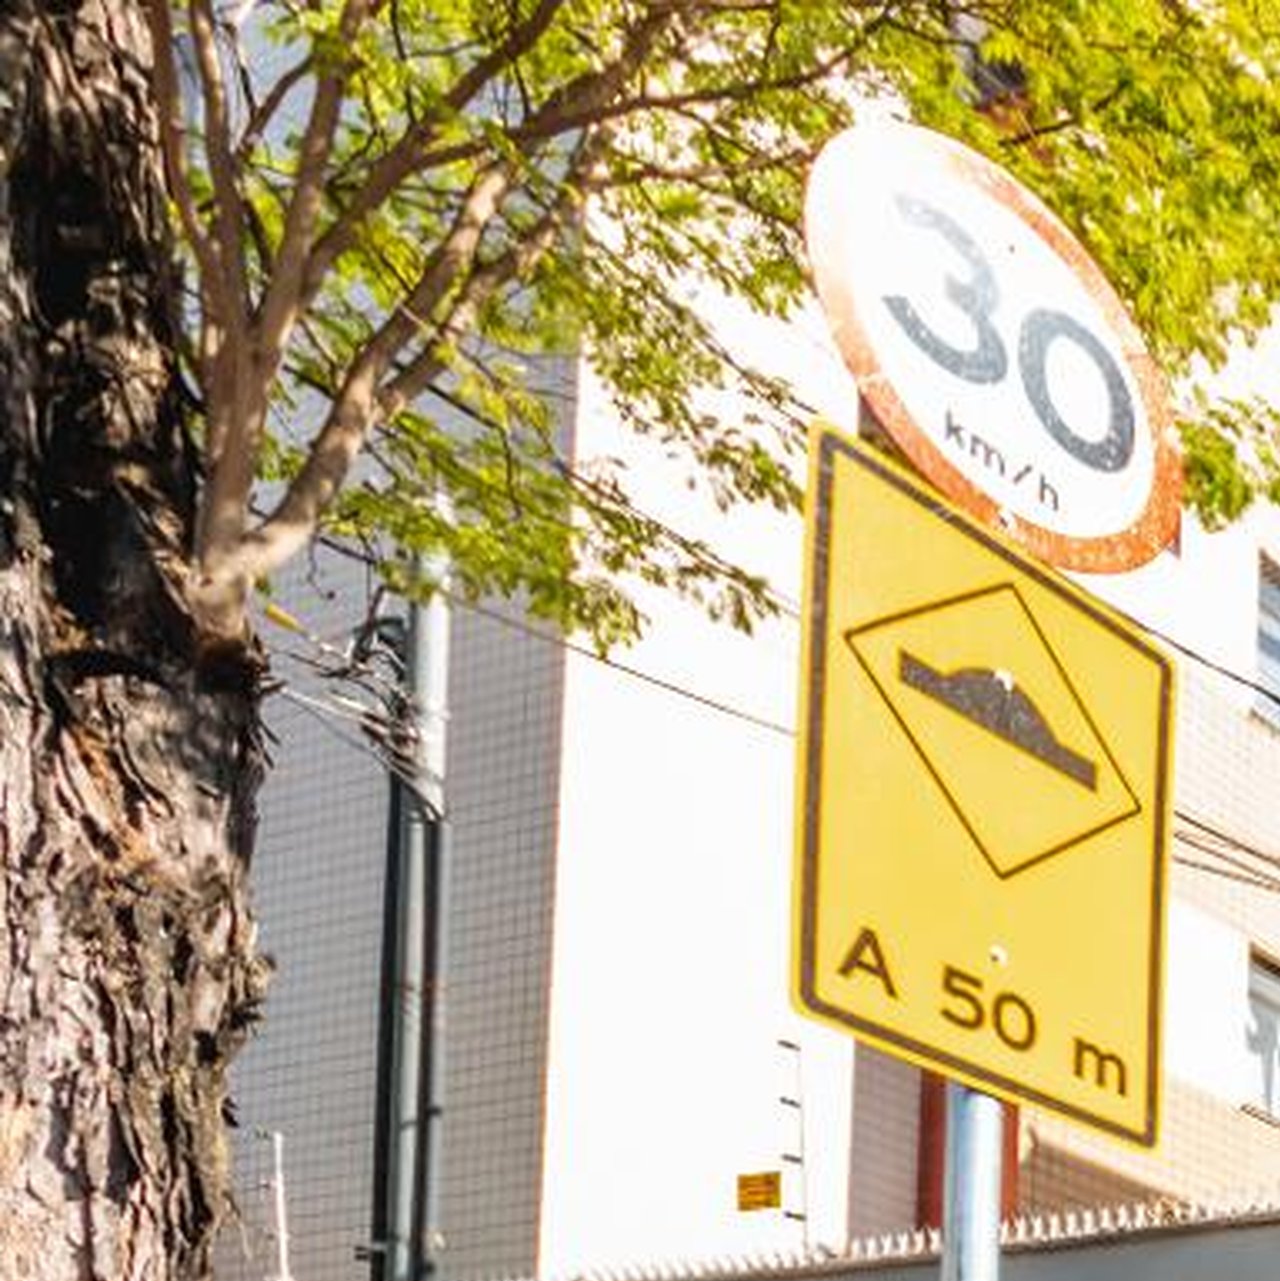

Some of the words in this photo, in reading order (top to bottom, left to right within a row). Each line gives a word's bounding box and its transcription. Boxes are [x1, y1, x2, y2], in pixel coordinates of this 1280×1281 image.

[882, 193, 1135, 473] 30
[944, 409, 1059, 512] km/h
[837, 927, 898, 999] A
[940, 964, 1036, 1052] 50
[1072, 1037, 1127, 1097] m
